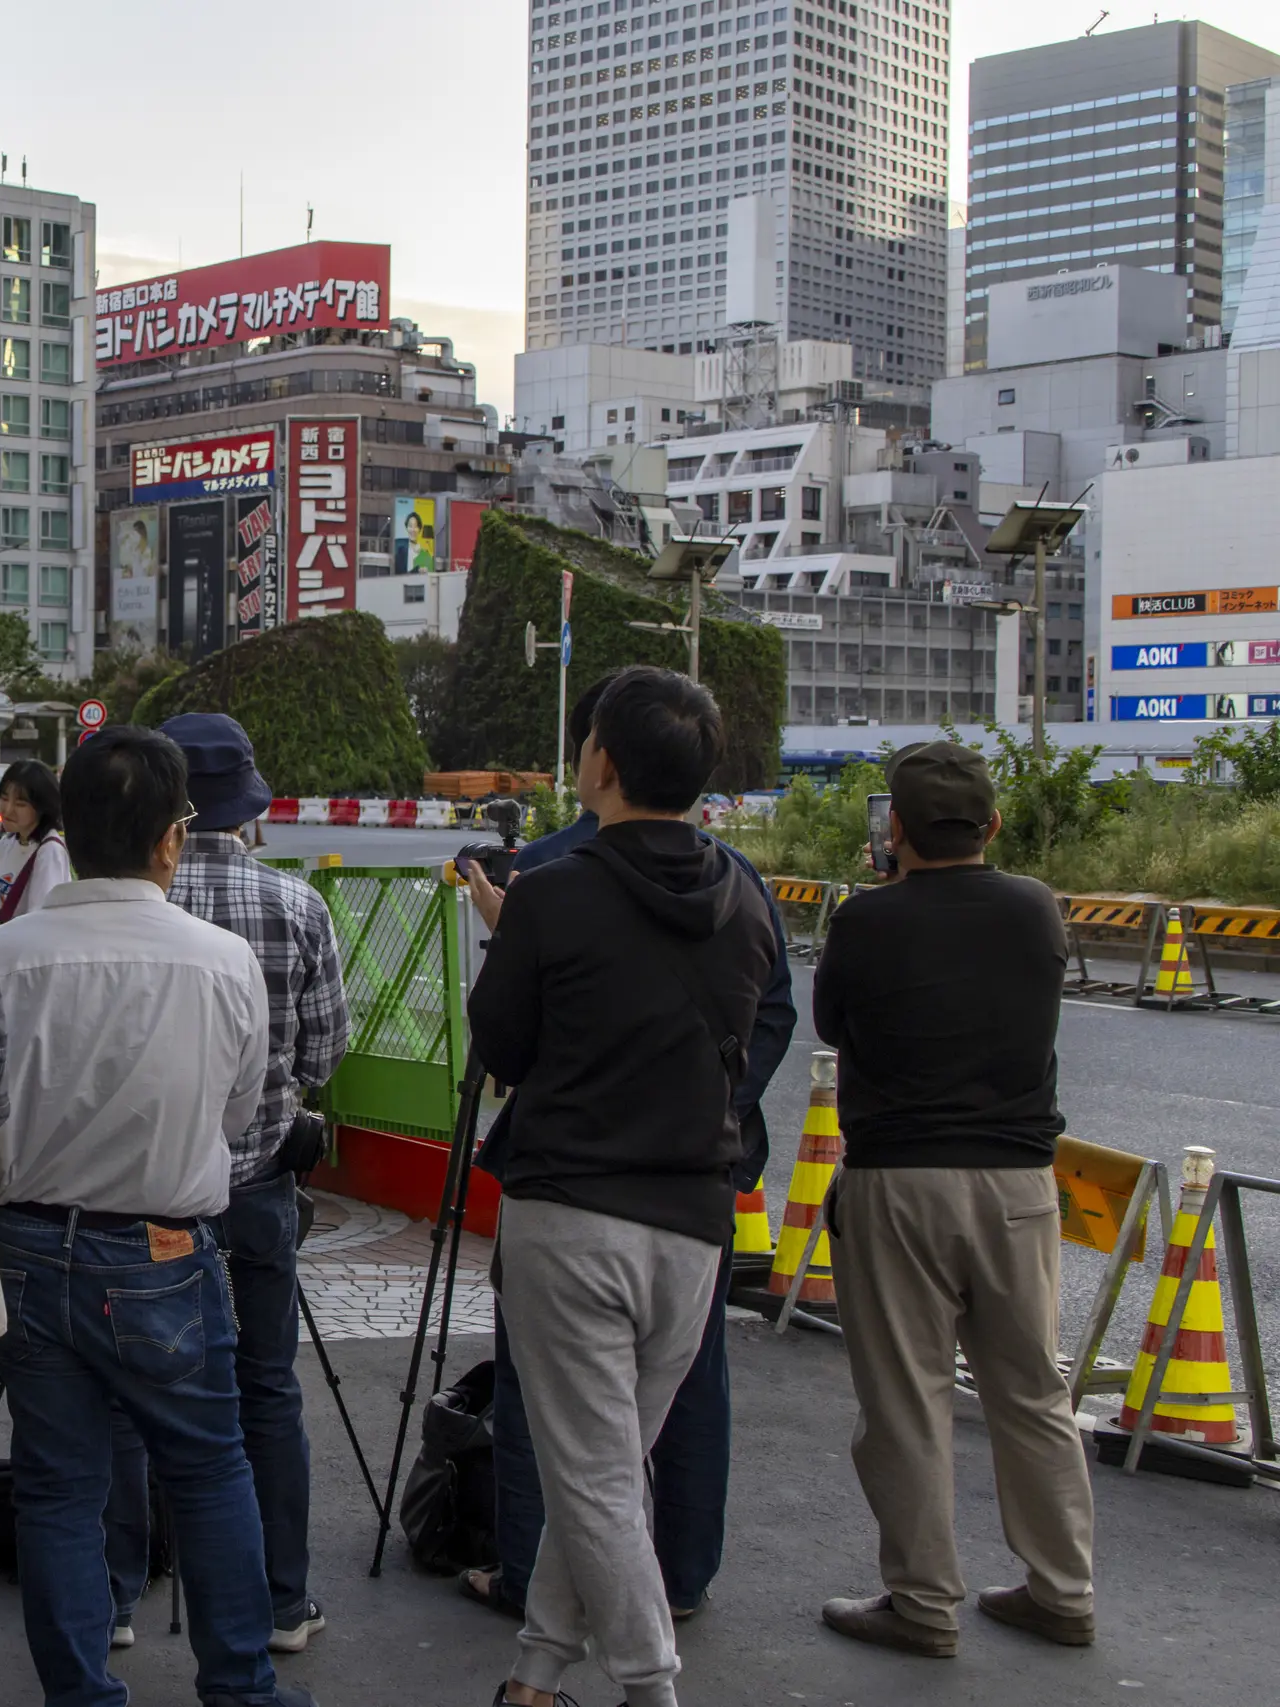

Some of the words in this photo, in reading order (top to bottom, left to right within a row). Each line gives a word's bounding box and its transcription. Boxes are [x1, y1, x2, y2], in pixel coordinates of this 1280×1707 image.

[96, 278, 178, 315] 新宿西口本店
[135, 441, 271, 487] ヨドバシカメラ
[238, 500, 271, 548] TAX
[1139, 597, 1196, 612] 快活CLUB
[1221, 590, 1255, 601] コミック
[1221, 600, 1277, 612] インターネット
[1136, 646, 1178, 667] AOKI
[85, 708, 100, 721] 40
[1135, 697, 1177, 718] AOKI
